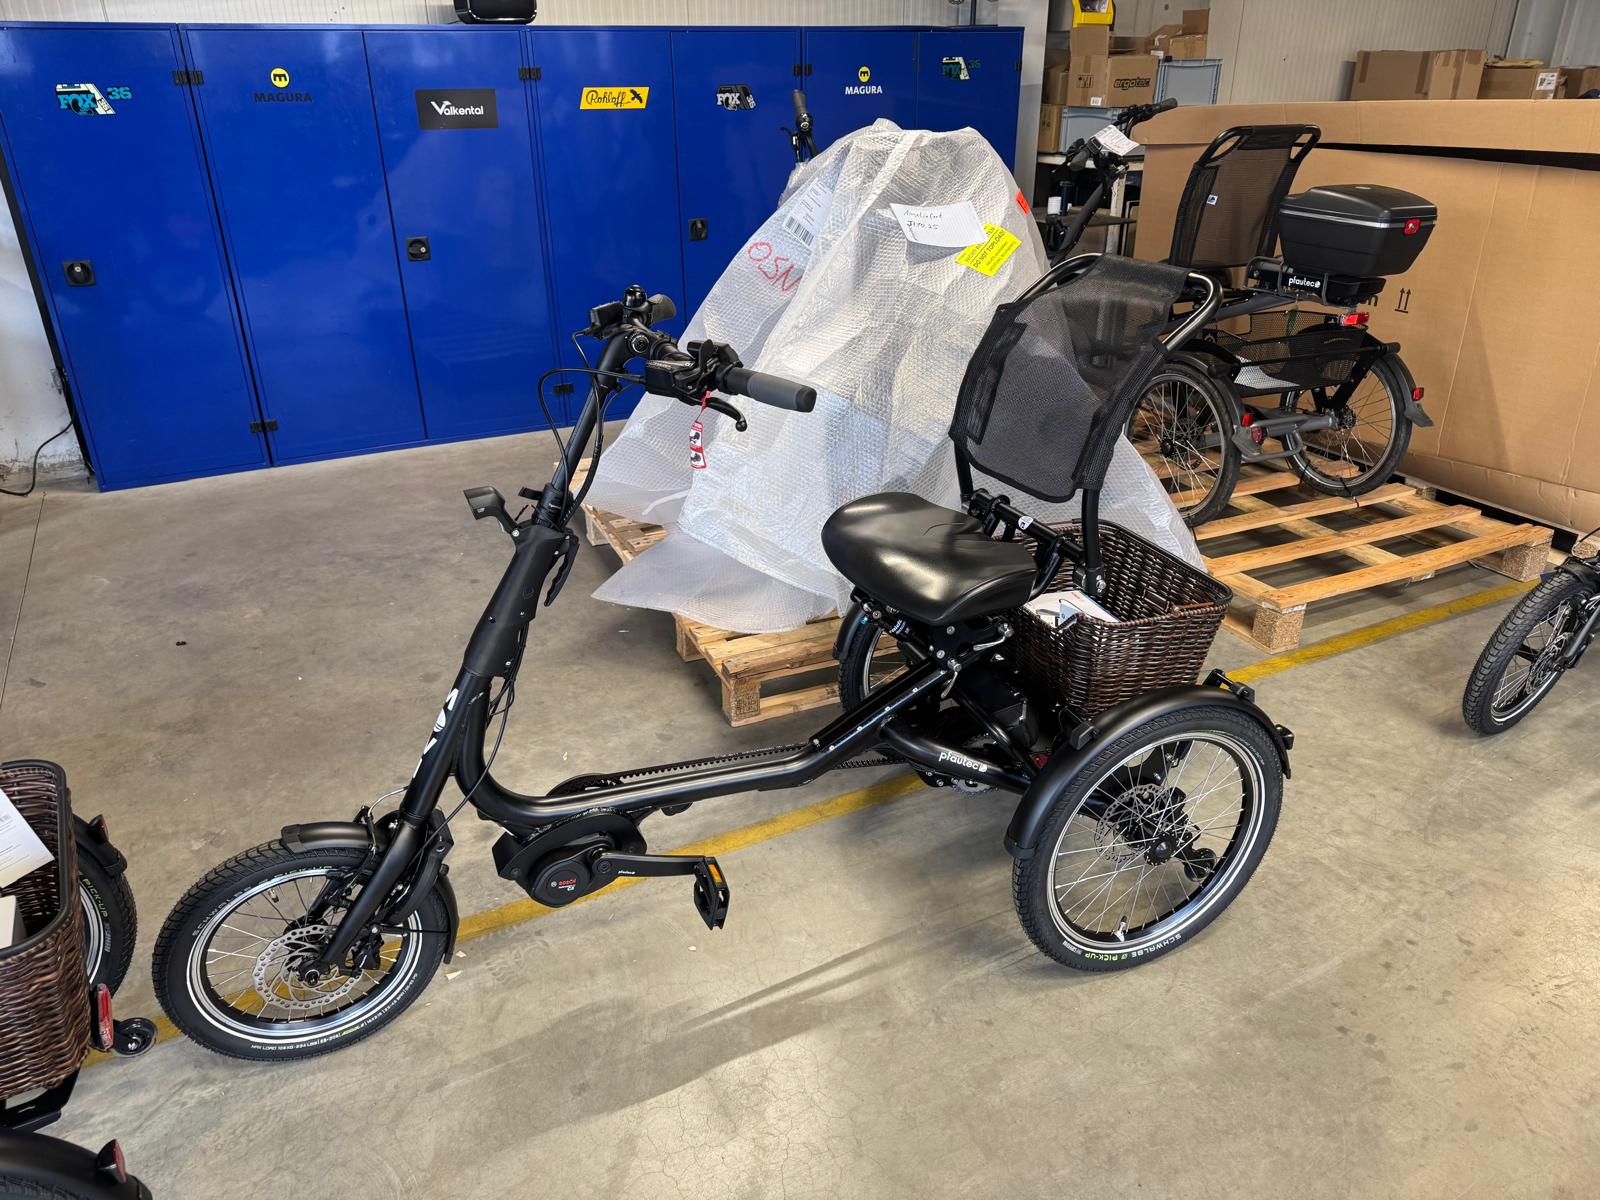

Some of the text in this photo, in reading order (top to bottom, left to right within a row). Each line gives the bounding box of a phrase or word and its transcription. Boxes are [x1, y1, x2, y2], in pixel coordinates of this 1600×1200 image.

[845, 85, 883, 95] MAGURA
[1113, 77, 1151, 91] ergotec
[57, 86, 133, 116] FOX 36
[254, 92, 313, 103] MAGURA
[585, 89, 628, 108] Rohloff
[716, 92, 741, 111] FOX
[430, 100, 484, 116] Valkental
[973, 259, 982, 268] DO
[979, 250, 989, 261] NOT
[1288, 276, 1315, 287] pfautec
[938, 751, 980, 770] pfautec
[82, 878, 108, 917] PICK-UP
[1084, 934, 1182, 961] SCHWALBE PICK-UP
